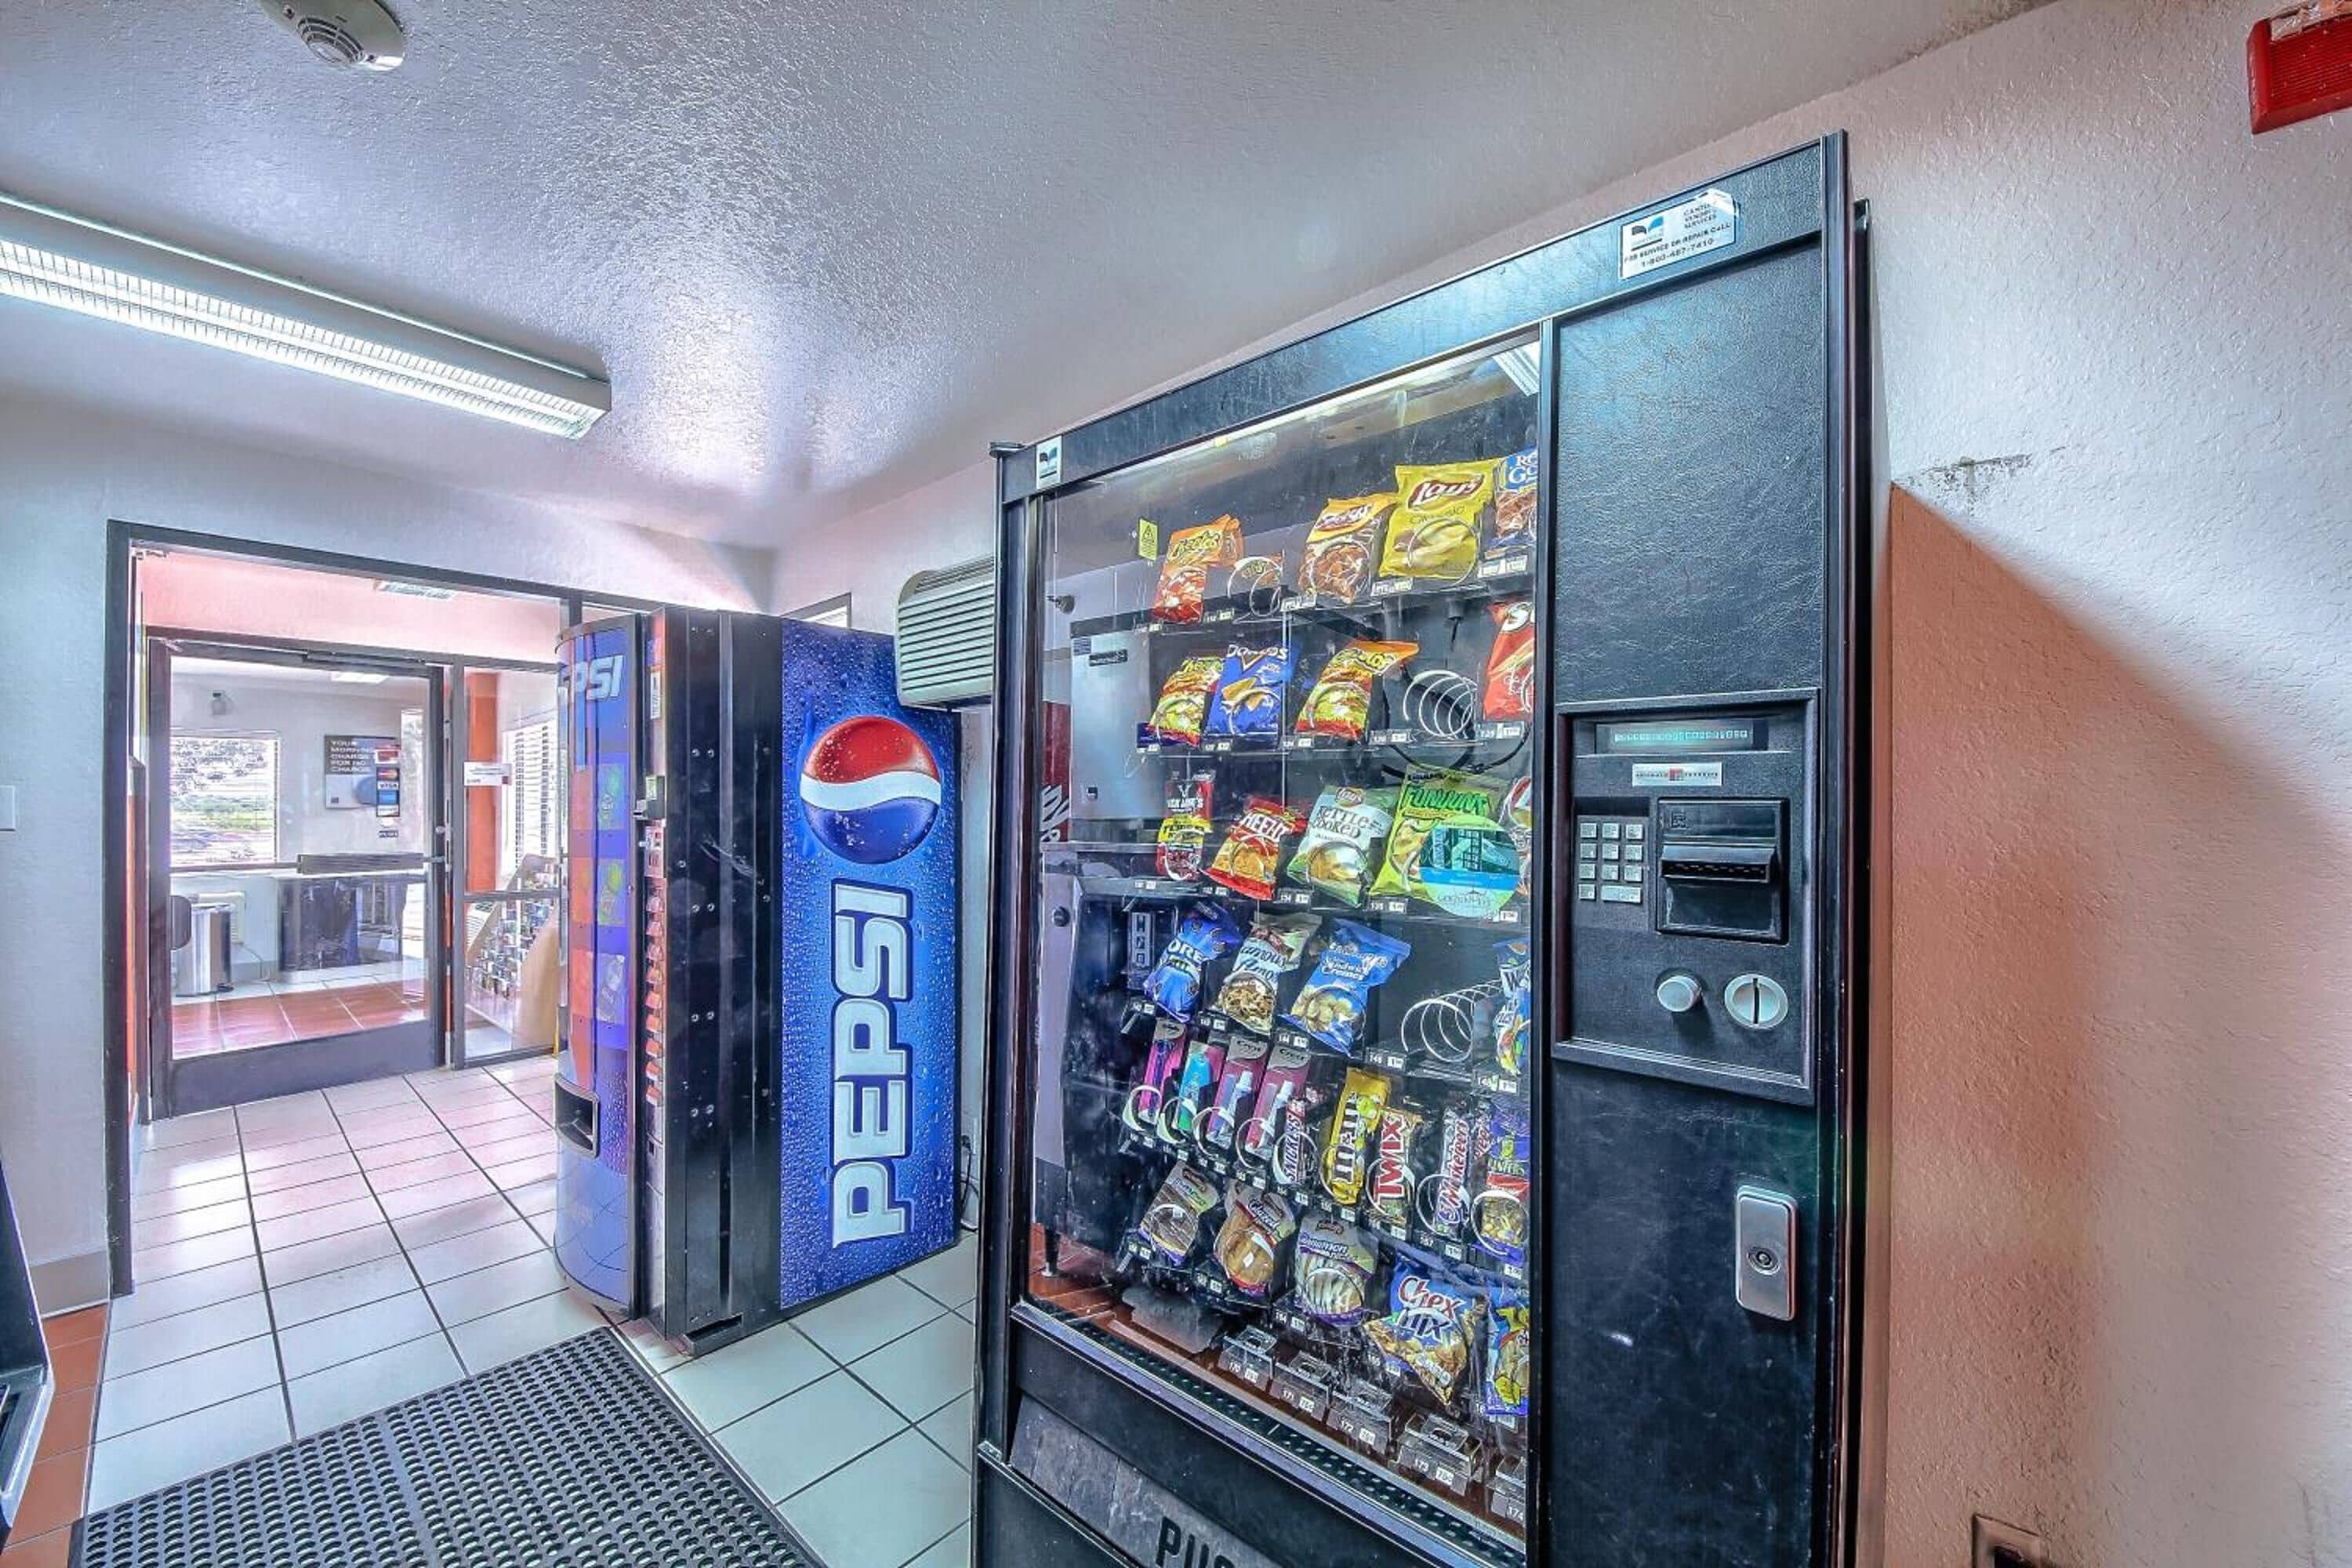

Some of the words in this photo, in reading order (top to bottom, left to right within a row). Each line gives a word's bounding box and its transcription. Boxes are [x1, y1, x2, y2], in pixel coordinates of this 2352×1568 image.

[1639, 243, 1668, 258] SERVICE
[832, 883, 908, 1250] PEPSI
[1376, 1115, 1406, 1205] TWIX
